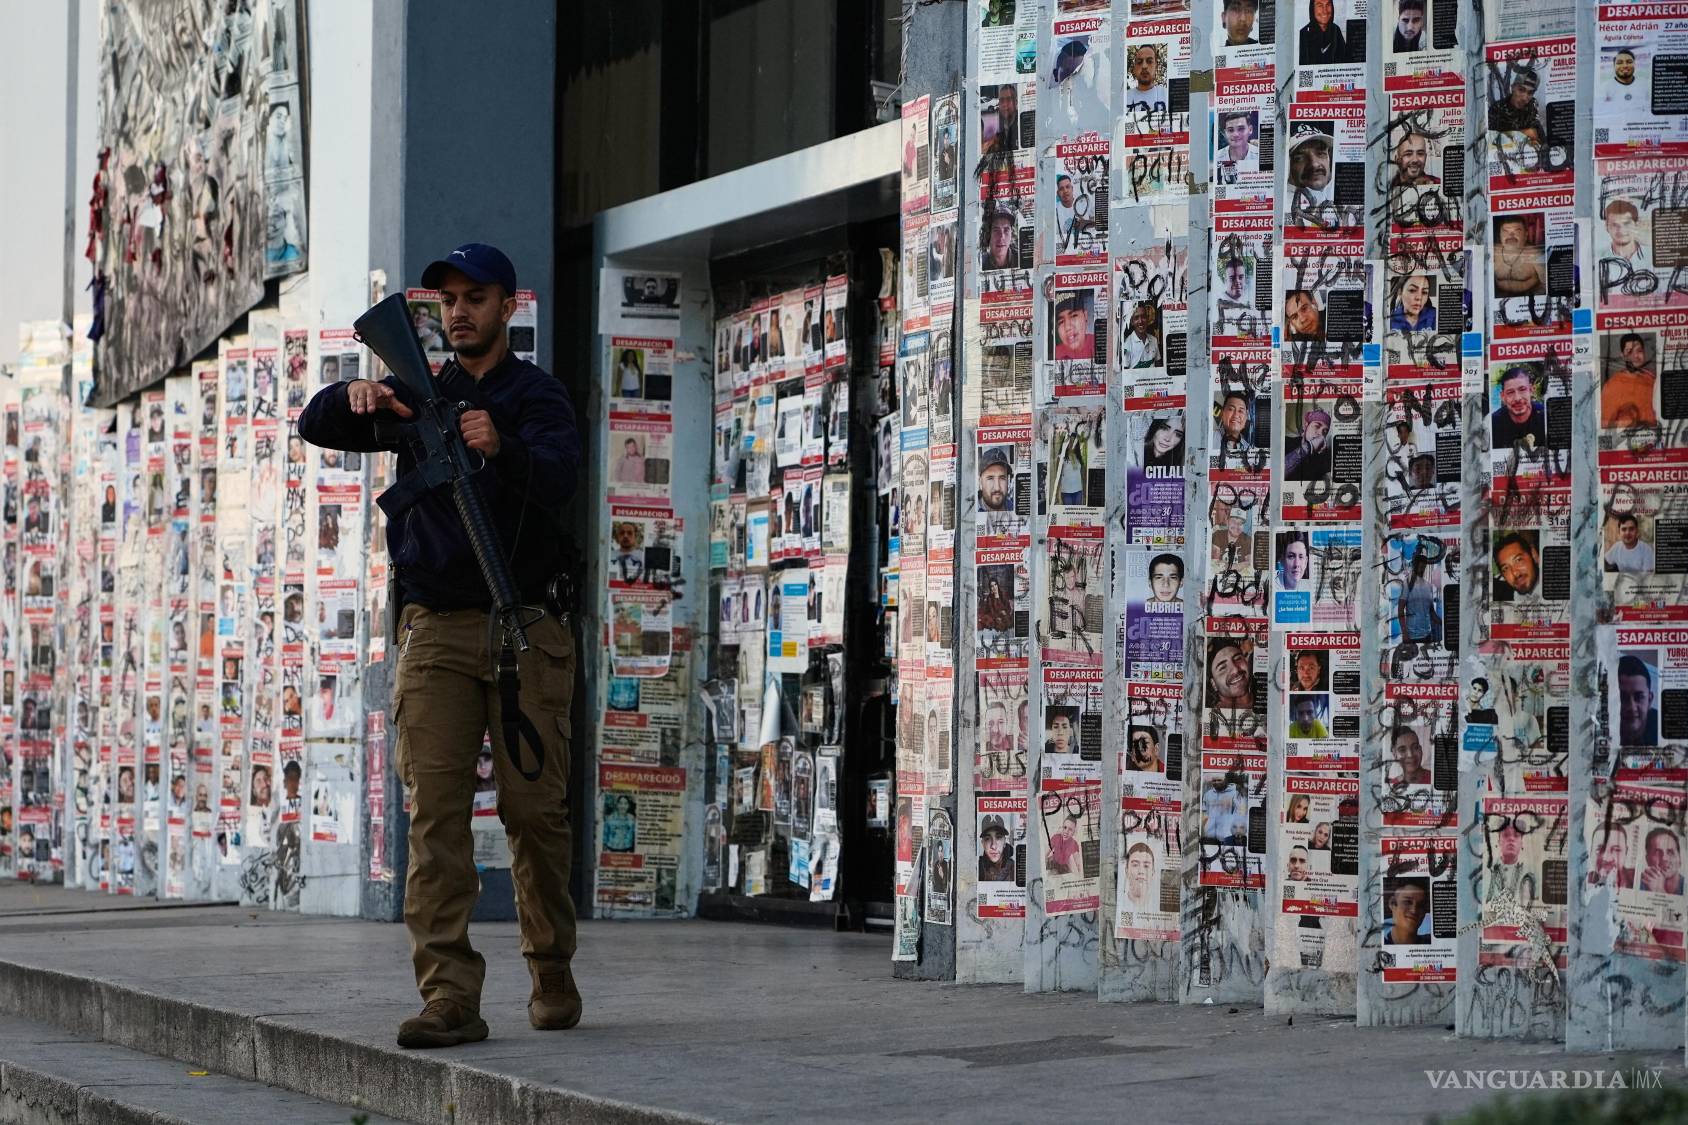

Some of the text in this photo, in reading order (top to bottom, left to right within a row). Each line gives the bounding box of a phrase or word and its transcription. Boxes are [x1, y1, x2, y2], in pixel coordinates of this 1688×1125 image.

[1599, 23, 1628, 33] Héctor
[1630, 21, 1659, 32] Adrián
[1439, 117, 1464, 126] Jimene
[1144, 600, 1184, 614] GABRIEL
[605, 770, 681, 785] DESAPARECIDO
